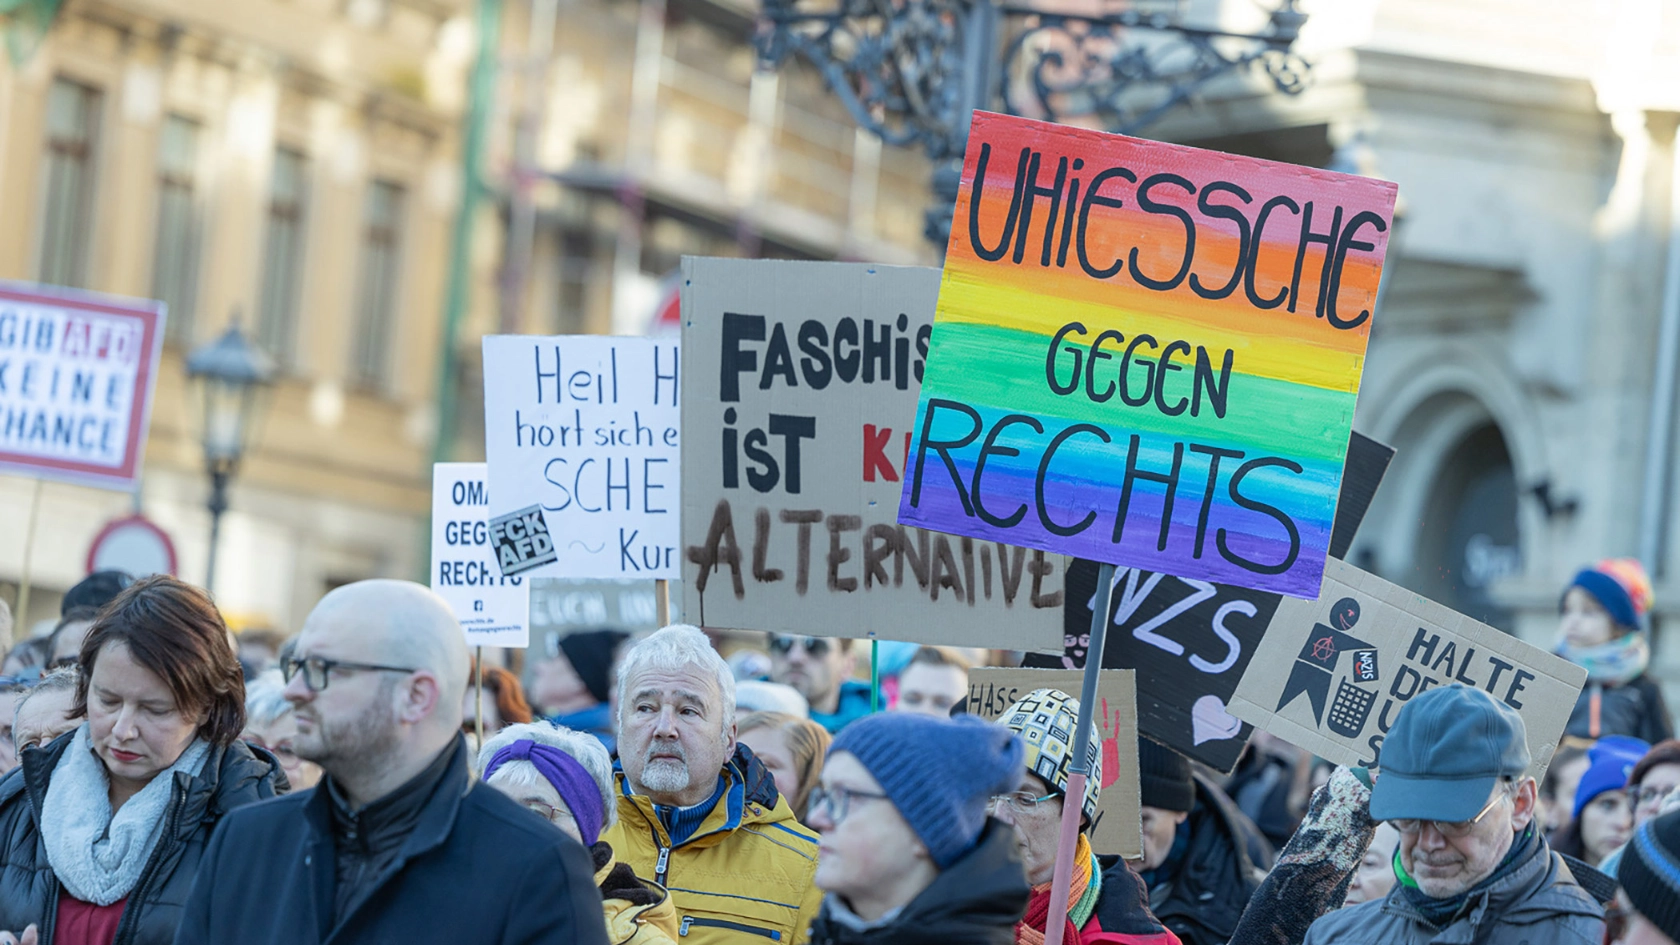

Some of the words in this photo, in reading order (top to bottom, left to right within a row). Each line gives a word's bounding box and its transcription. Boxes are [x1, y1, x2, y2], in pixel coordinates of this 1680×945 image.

[535, 345, 617, 404] Heil
[653, 345, 679, 407] H
[719, 311, 934, 403] FASCHiS
[1045, 321, 1234, 419] GEGEN
[0, 402, 119, 453] HANCE
[594, 411, 653, 447] sich
[662, 426, 679, 447] e
[452, 480, 489, 506] OM
[540, 457, 669, 514] SCHE
[910, 398, 1304, 576] RECHTS
[445, 520, 487, 546] GEG
[489, 511, 547, 547] FCK
[500, 533, 554, 568] AFD
[619, 527, 678, 572] Kur
[1358, 651, 1375, 680] NAZIS
[1405, 627, 1535, 711] HALTE
